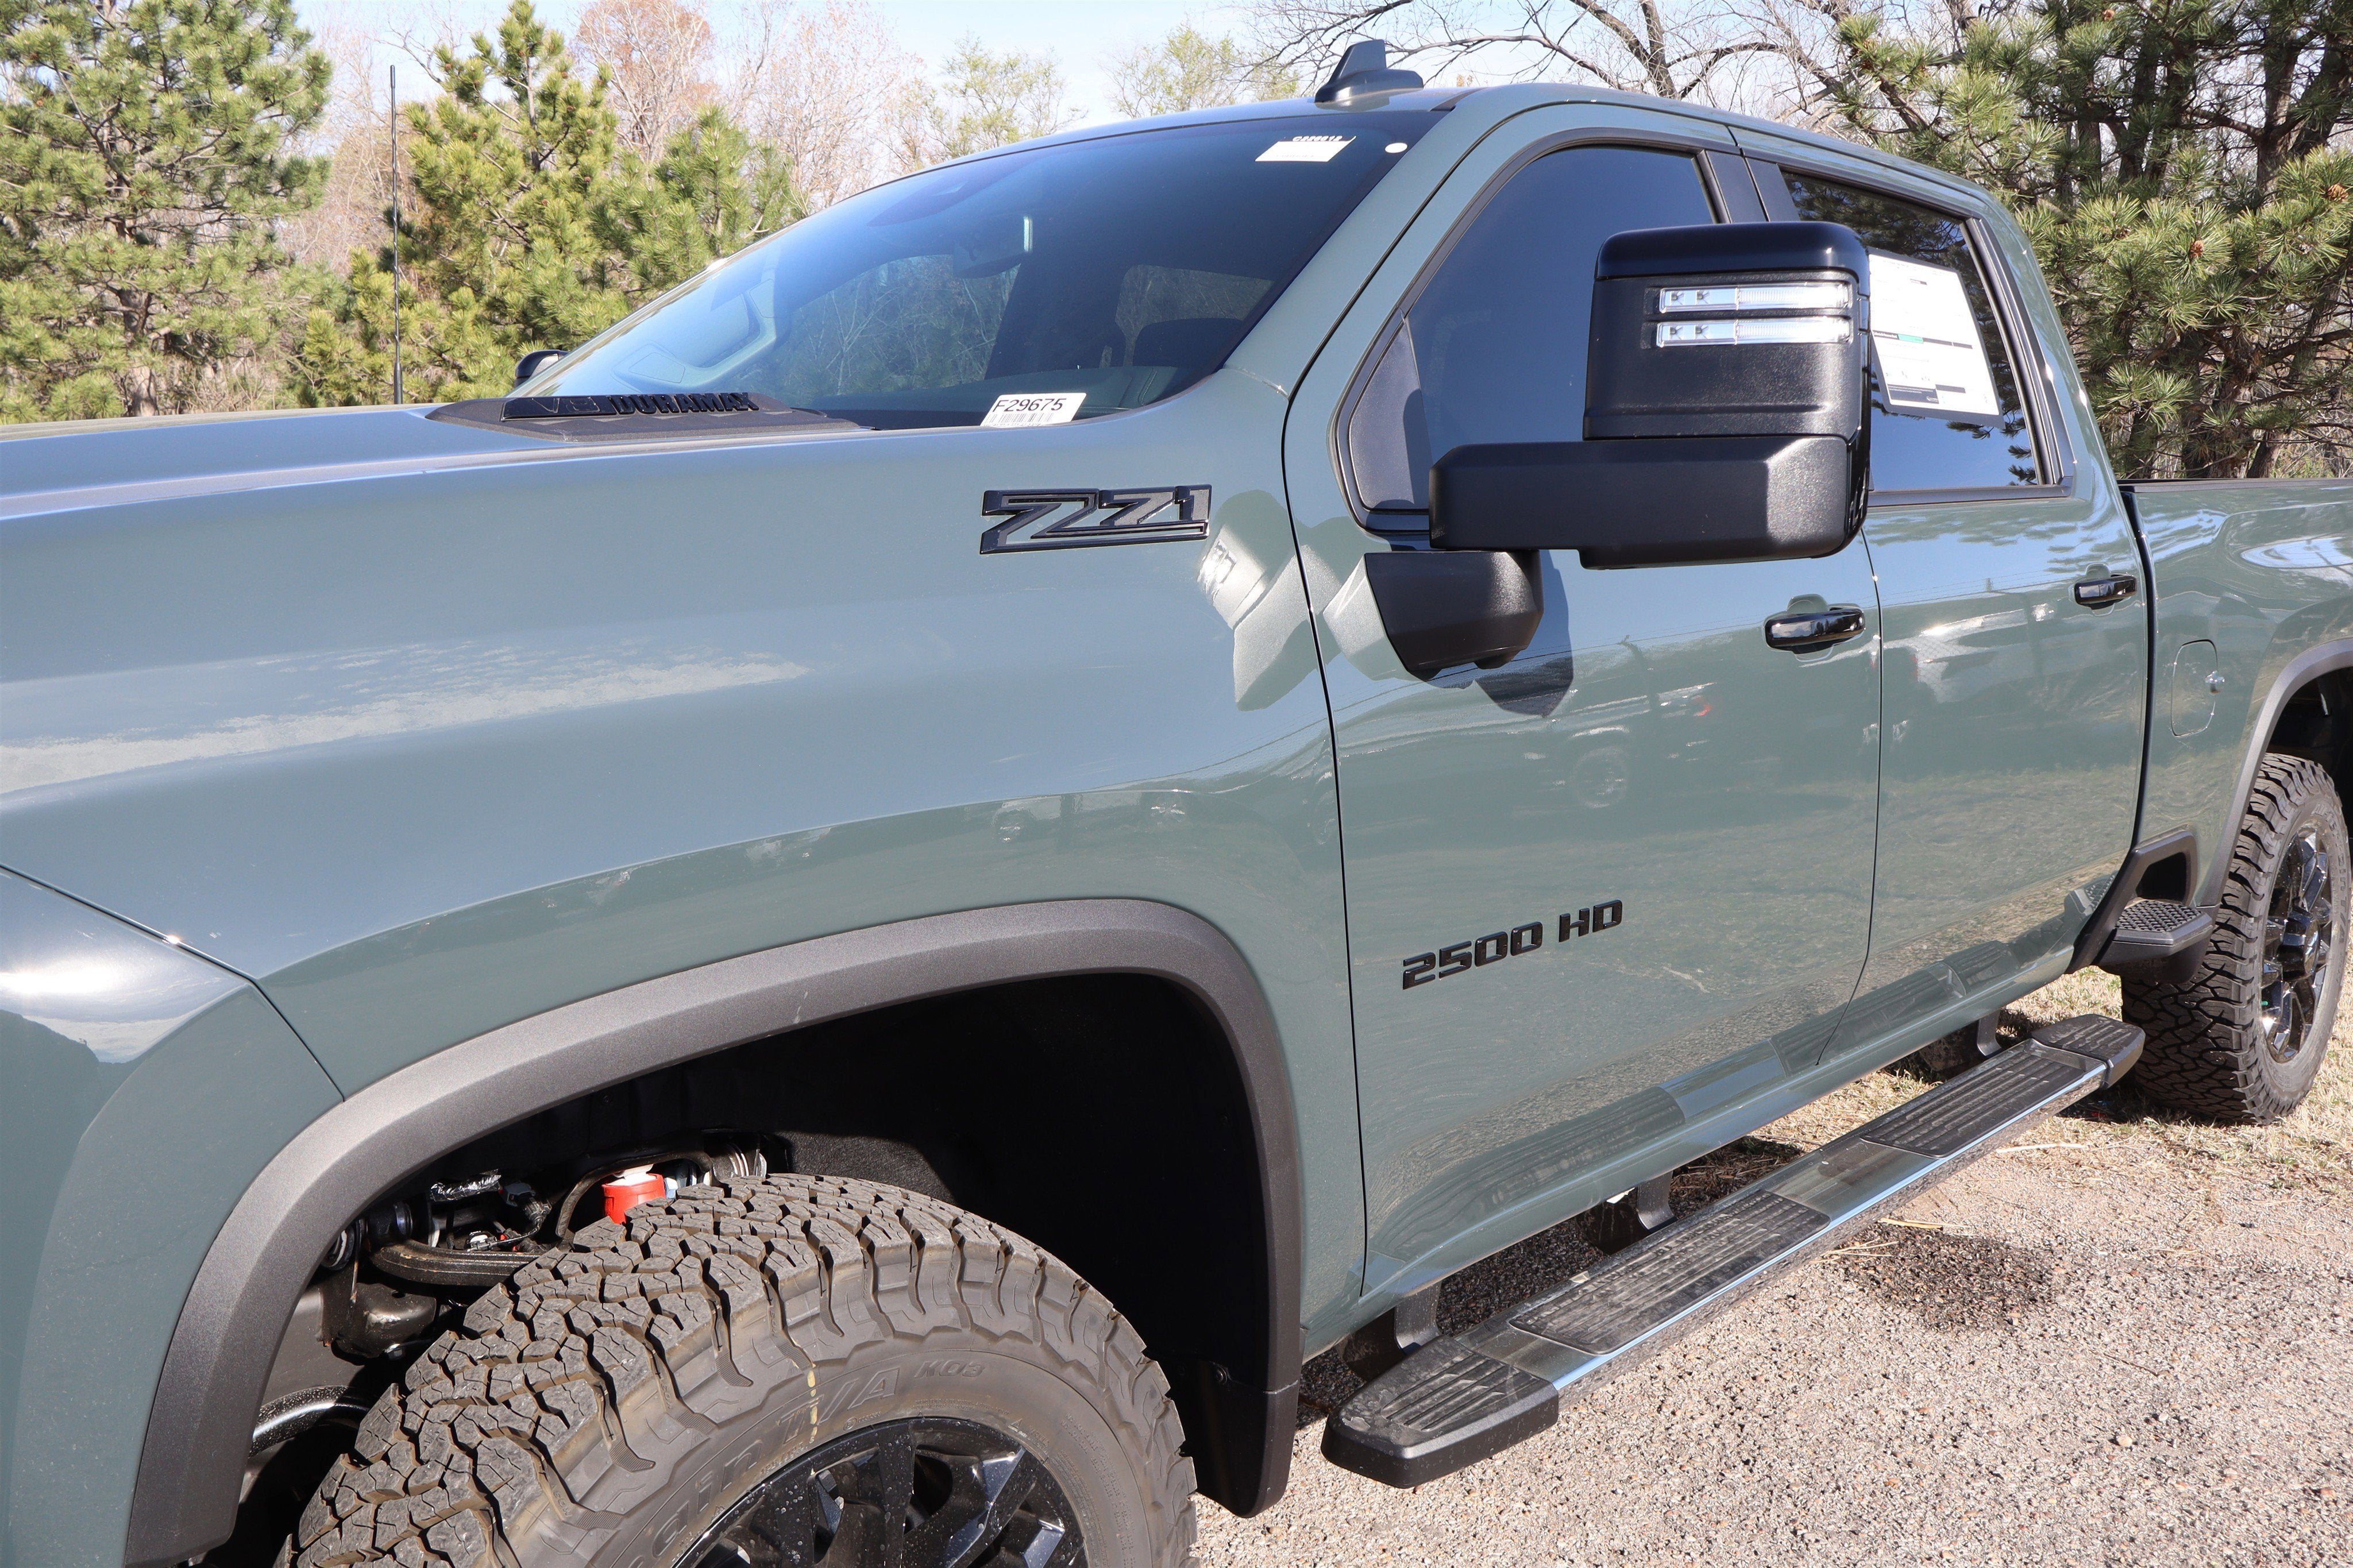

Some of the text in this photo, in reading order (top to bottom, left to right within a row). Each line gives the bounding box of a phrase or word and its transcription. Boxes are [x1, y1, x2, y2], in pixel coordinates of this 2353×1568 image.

[607, 392, 759, 415] DURAMAX
[992, 397, 1067, 413] F29675
[980, 484, 1212, 554] Z71
[1402, 899, 1623, 990] 2500 HD
[913, 1359, 986, 1378] KO3
